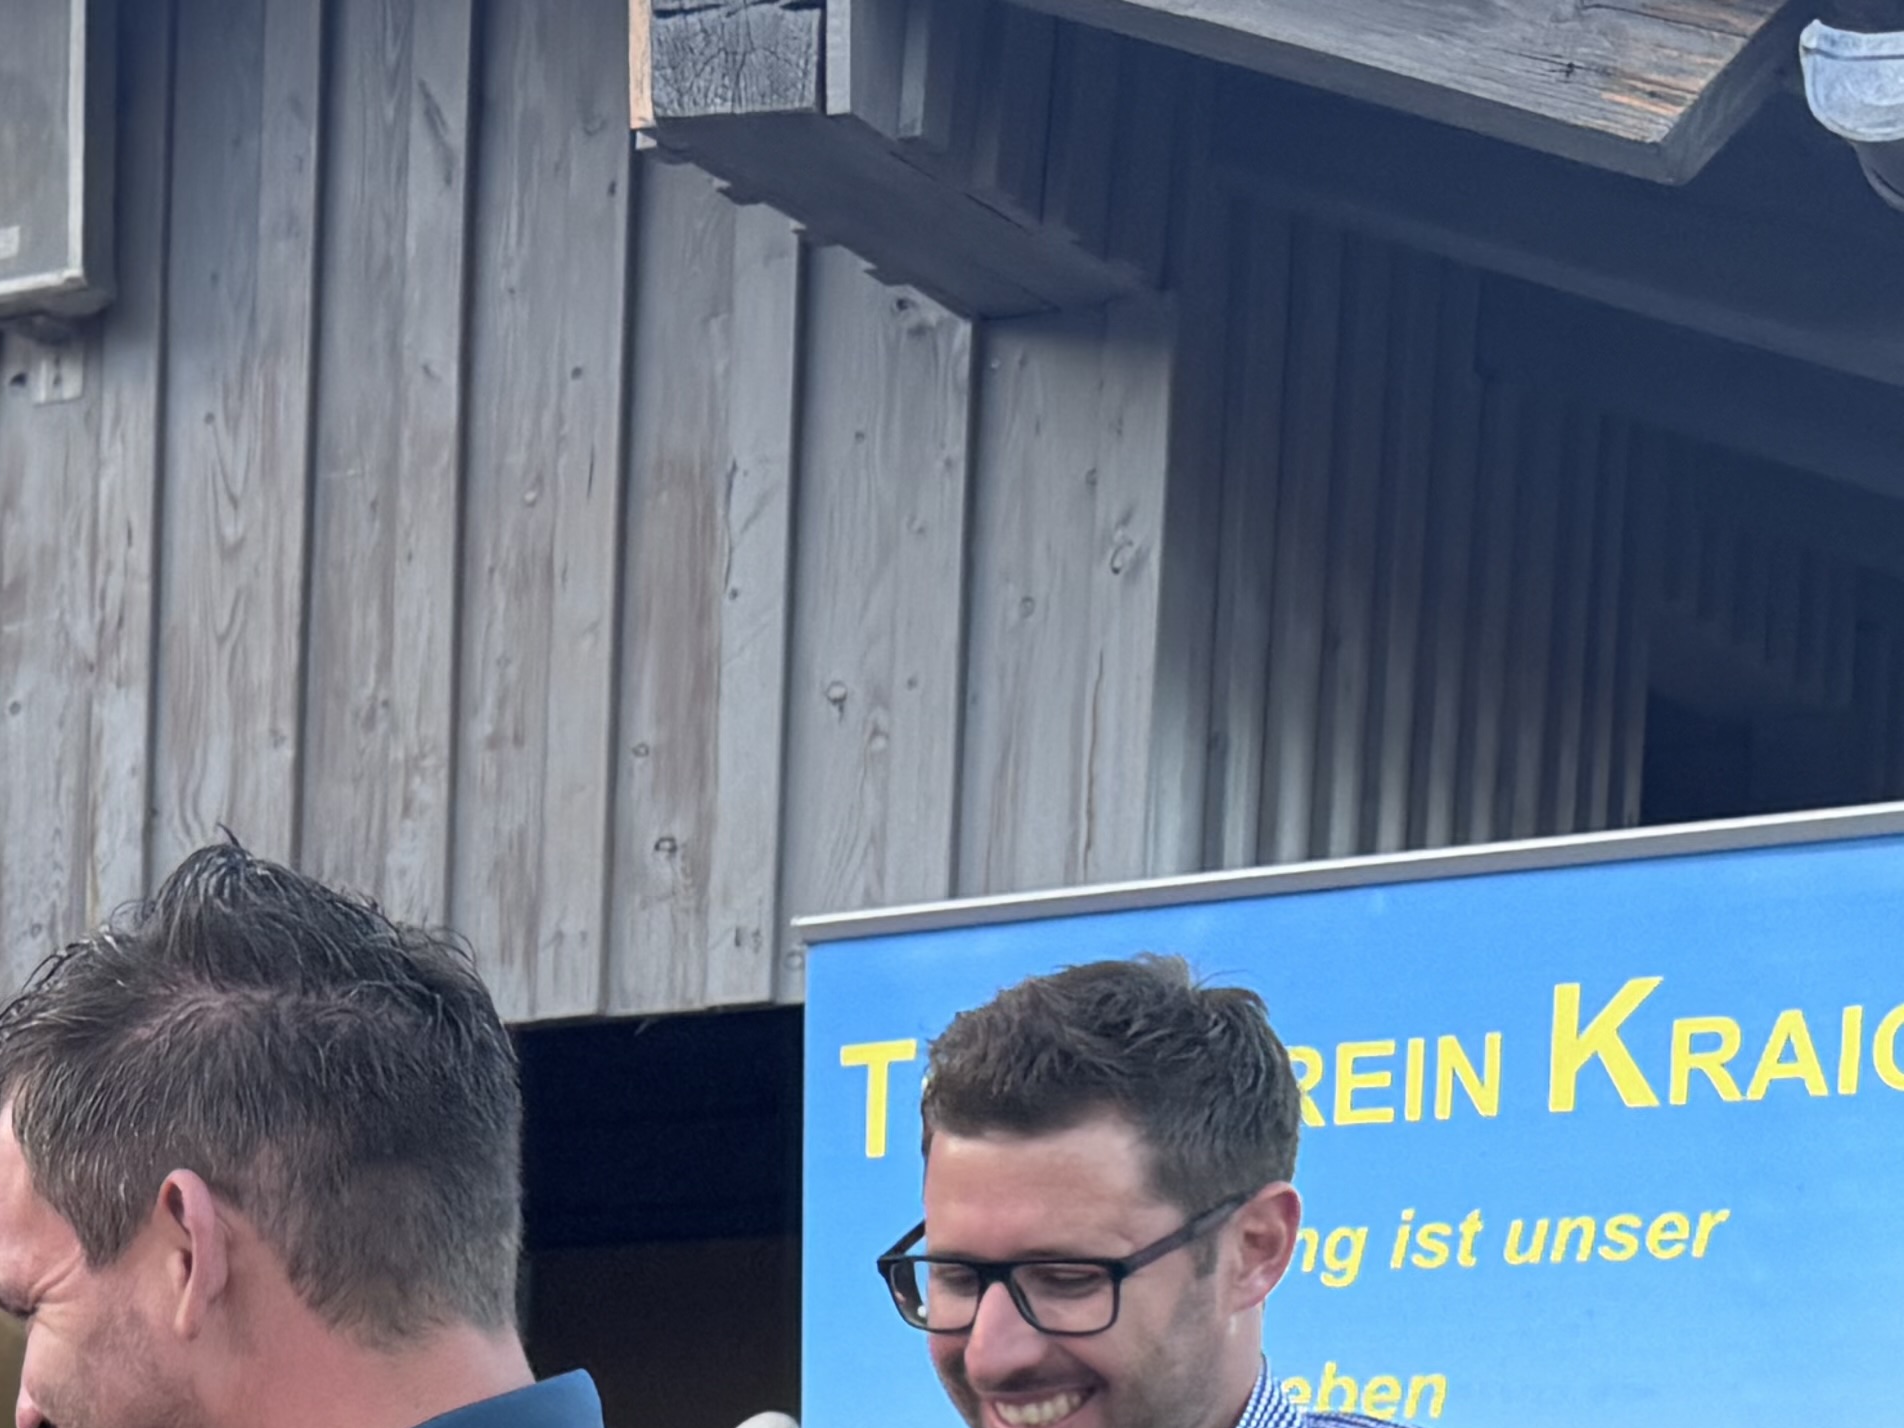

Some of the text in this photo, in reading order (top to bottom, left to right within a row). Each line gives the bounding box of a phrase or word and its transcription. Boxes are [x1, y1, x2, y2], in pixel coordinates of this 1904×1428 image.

[1390, 1208, 1484, 1269] ist
[1503, 1208, 1730, 1265] unser
[1281, 1361, 1447, 1419] eben
